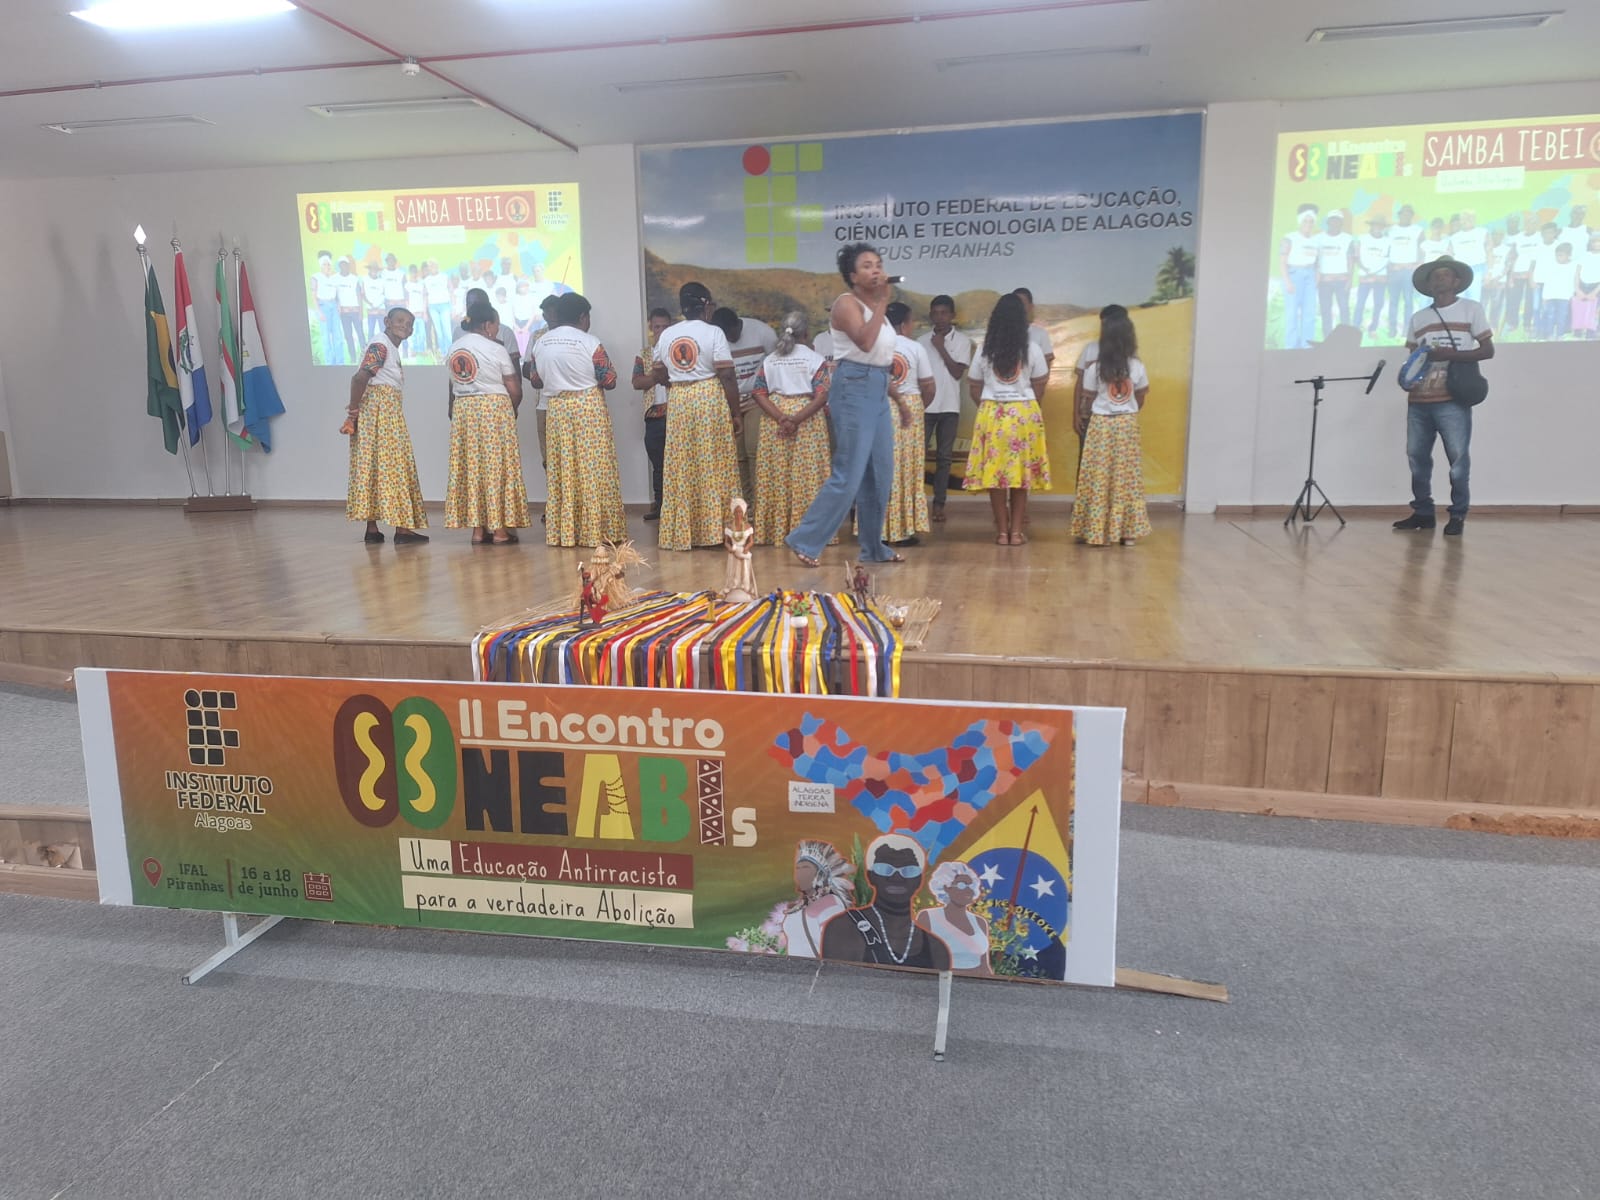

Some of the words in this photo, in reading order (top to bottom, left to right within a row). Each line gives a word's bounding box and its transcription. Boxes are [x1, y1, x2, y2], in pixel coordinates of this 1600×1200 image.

[1425, 132, 1505, 168] SAMBA
[1518, 127, 1585, 162] TEBEI
[397, 198, 450, 224] SAMBA
[455, 195, 504, 222] TEBEI
[937, 197, 1022, 215] FEDERAL
[1032, 194, 1056, 211] DE
[834, 220, 907, 241] CIÊNCIA
[914, 222, 925, 238] E
[931, 216, 1055, 236] TECNOLOGIA
[1062, 214, 1087, 232] DE
[1093, 211, 1193, 231] ALAGOAS
[837, 243, 911, 260] CPUS
[918, 241, 1014, 260] PIRANHAS
[498, 700, 724, 749] Encontro
[165, 771, 273, 795] INSTITUTO
[178, 791, 265, 814] FEDERAL
[195, 813, 252, 832] Alagoas
[179, 863, 208, 877] IFAL
[241, 867, 257, 880] 16
[263, 871, 272, 881] a
[275, 868, 291, 882] 18
[410, 840, 450, 872] Uma
[460, 843, 547, 883] Educação
[558, 849, 677, 886] Antirracista
[167, 878, 224, 893] Piranhas
[238, 881, 254, 895] de
[258, 883, 299, 899] junho
[416, 892, 457, 922] para
[467, 897, 477, 910] a
[487, 887, 585, 918] verdadeira
[596, 890, 676, 929] Abolição
